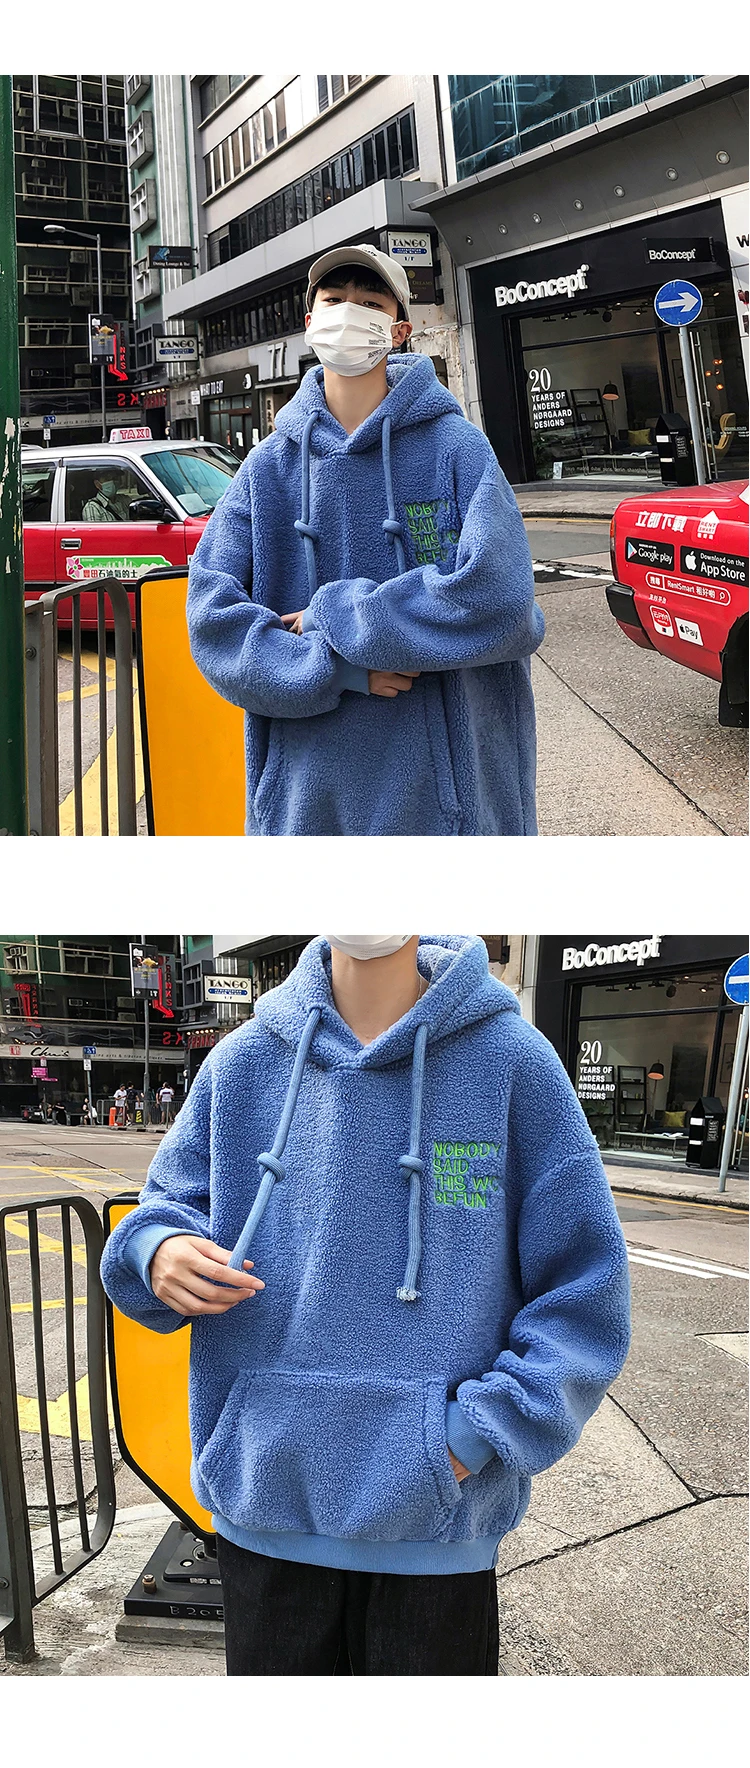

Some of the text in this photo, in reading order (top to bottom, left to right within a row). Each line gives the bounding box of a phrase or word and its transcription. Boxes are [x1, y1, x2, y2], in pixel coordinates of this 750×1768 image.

[392, 238, 427, 248] TANGO
[649, 248, 697, 260] BoConcept
[494, 264, 590, 307] BoConcept
[158, 340, 194, 348] TANGO
[529, 368, 552, 392] 20
[531, 393, 553, 402] YEARS
[532, 401, 560, 411] ANDERS
[534, 419, 565, 429] DESIGNS
[120, 428, 150, 440] TAXI
[638, 548, 672, 565] Google play
[700, 552, 726, 564] Download
[735, 558, 745, 567] the
[700, 561, 746, 581] App Store
[685, 626, 697, 639] Pay
[562, 935, 662, 970] BoConcept
[208, 979, 248, 989] TANGO
[580, 1040, 602, 1065] 20
[578, 1092, 606, 1100] DESIGNS
[434, 1141, 501, 1158] NOBODY
[433, 1158, 470, 1174] SAID
[434, 1174, 466, 1190] THIS
